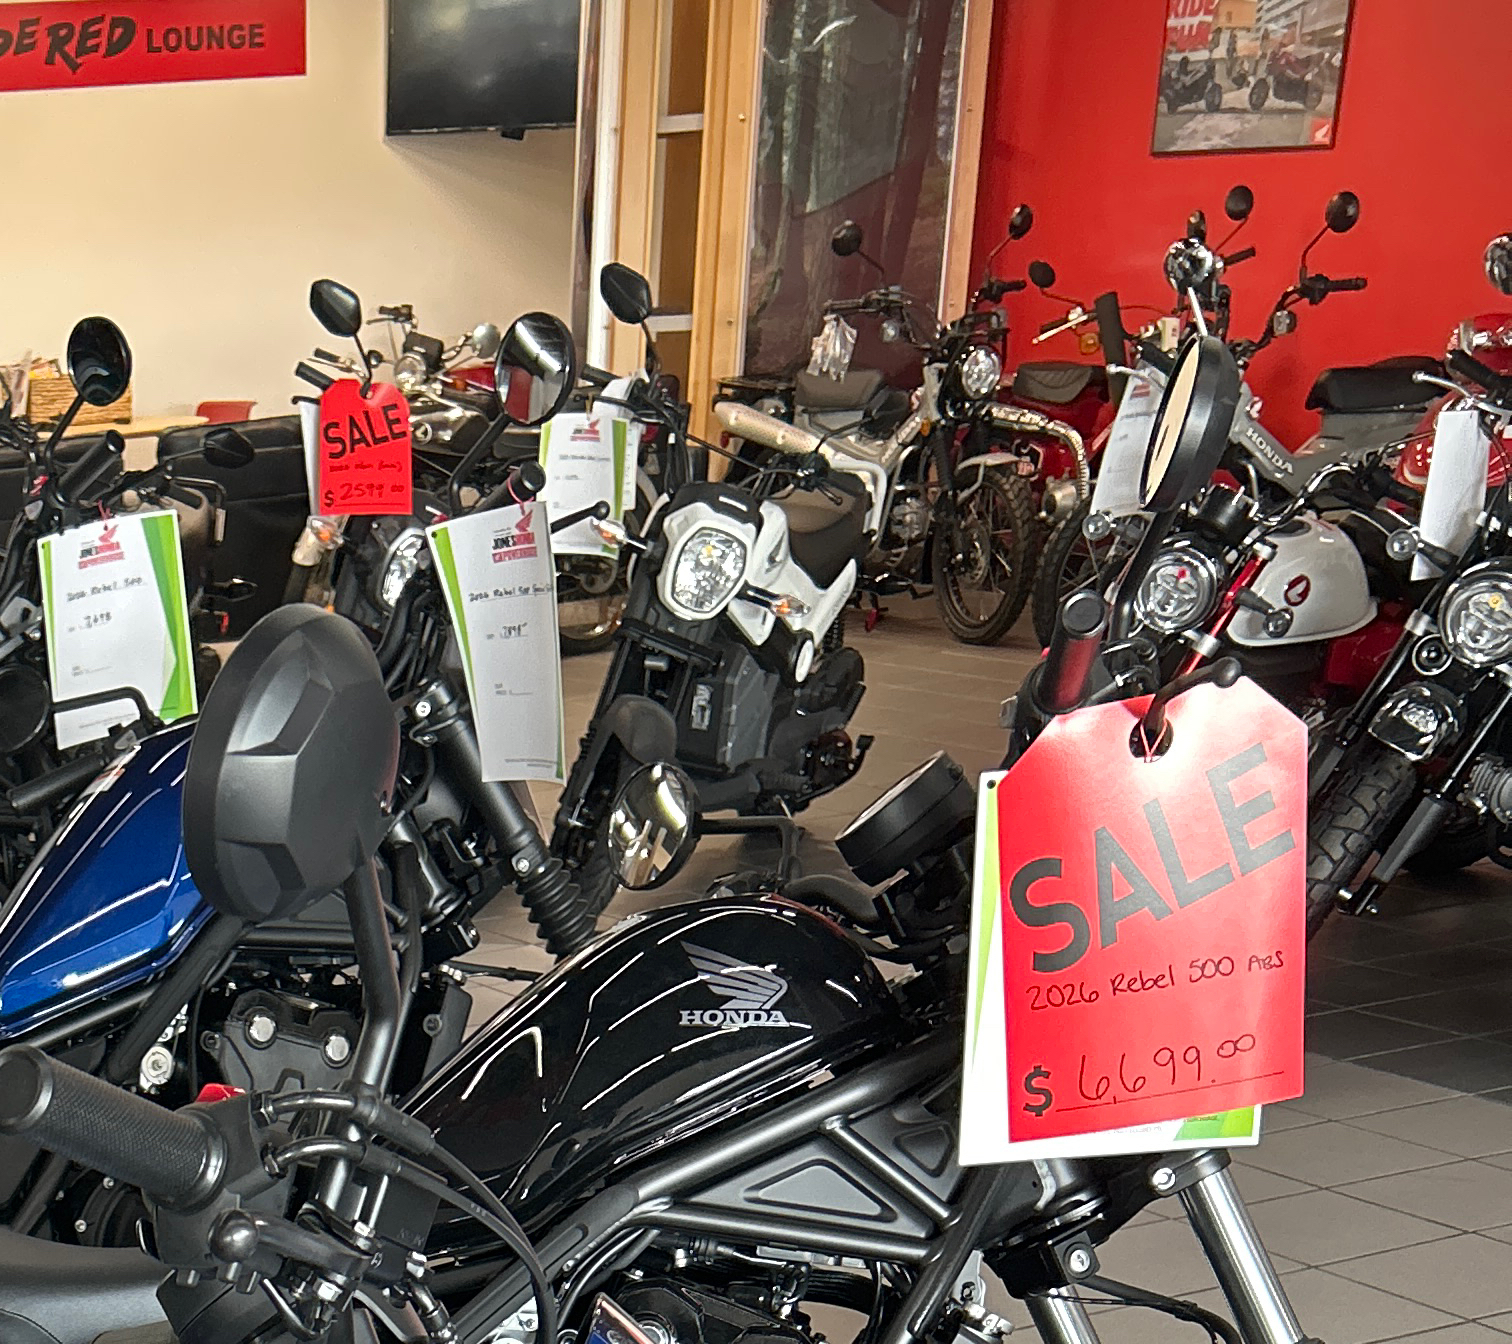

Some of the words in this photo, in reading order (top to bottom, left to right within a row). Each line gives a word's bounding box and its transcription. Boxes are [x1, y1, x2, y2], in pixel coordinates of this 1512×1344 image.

[45, 14, 136, 72] RED
[146, 23, 266, 54] LOUNGE
[323, 403, 407, 459] SALE
[1246, 427, 1294, 475] HONDA
[1010, 743, 1295, 973] SALE
[1026, 984, 1099, 1011] 2026
[1111, 964, 1175, 995] Rebel
[1188, 957, 1235, 984] 500
[679, 1009, 790, 1028] HONDA
[1023, 1064, 1053, 1116] $
